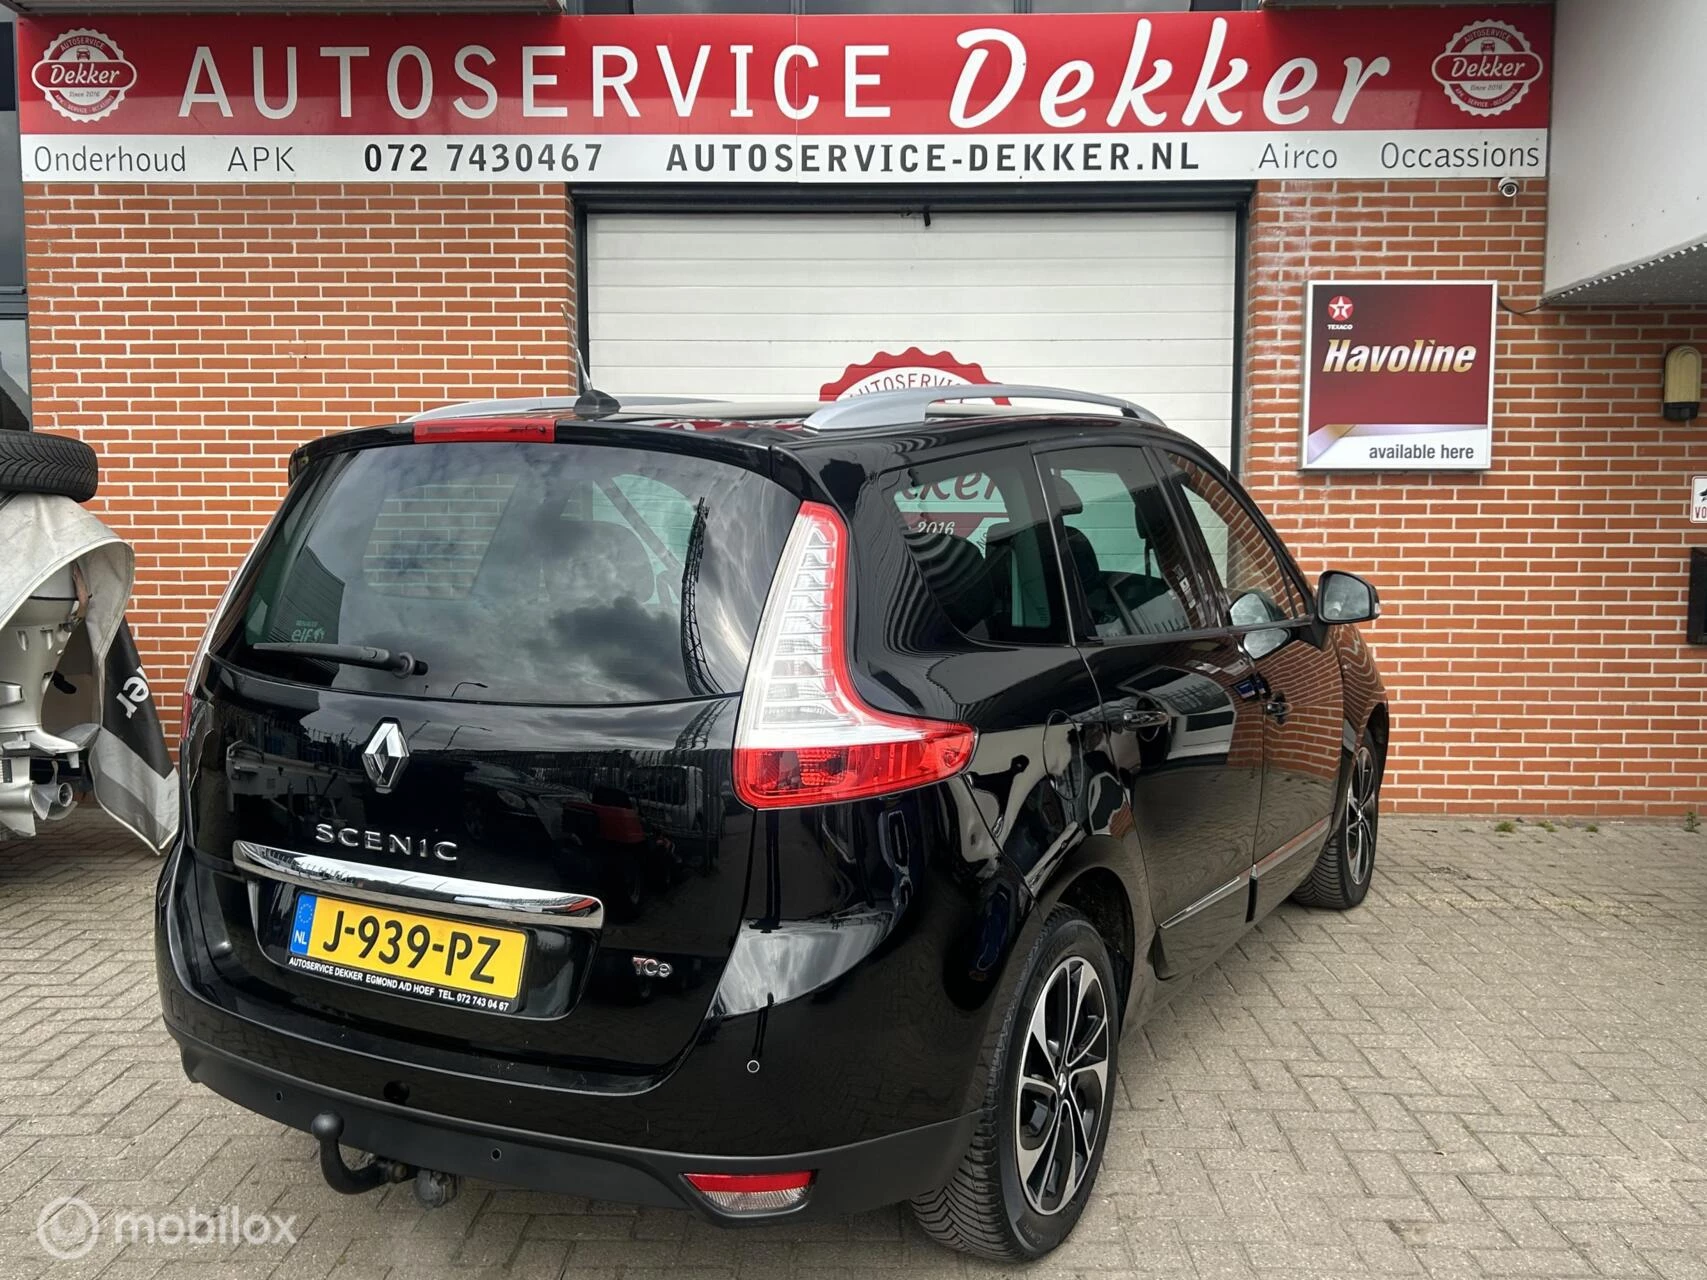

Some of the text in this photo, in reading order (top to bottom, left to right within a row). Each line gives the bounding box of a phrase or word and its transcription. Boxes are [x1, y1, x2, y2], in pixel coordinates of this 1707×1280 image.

[60, 37, 105, 51] AUTOSERVICE
[1464, 28, 1511, 43] AUTOSERVICE
[50, 63, 120, 85] Dekker
[177, 17, 1390, 129] AUTOSERVICE Dekker
[1451, 56, 1525, 77] Dekker
[34, 140, 1540, 173] Onderhoud APK 072 7430467 AUTOSERVICE-DEKKER.NL Airco Occassions
[1322, 339, 1477, 373] Havoline
[1369, 444, 1474, 459] available here
[315, 823, 459, 861] SCENIC
[293, 930, 307, 946] NL
[322, 910, 502, 984] J-939-PZ
[289, 957, 334, 974] AUTOSERVICE
[334, 967, 363, 982] DEKKER
[365, 973, 398, 989] EGMOND
[413, 985, 435, 996] HOEF
[438, 989, 455, 1001] TEL.
[456, 993, 471, 1005] 072
[472, 995, 487, 1008] 743
[487, 1000, 498, 1009] 04
[498, 1002, 509, 1012] 67
